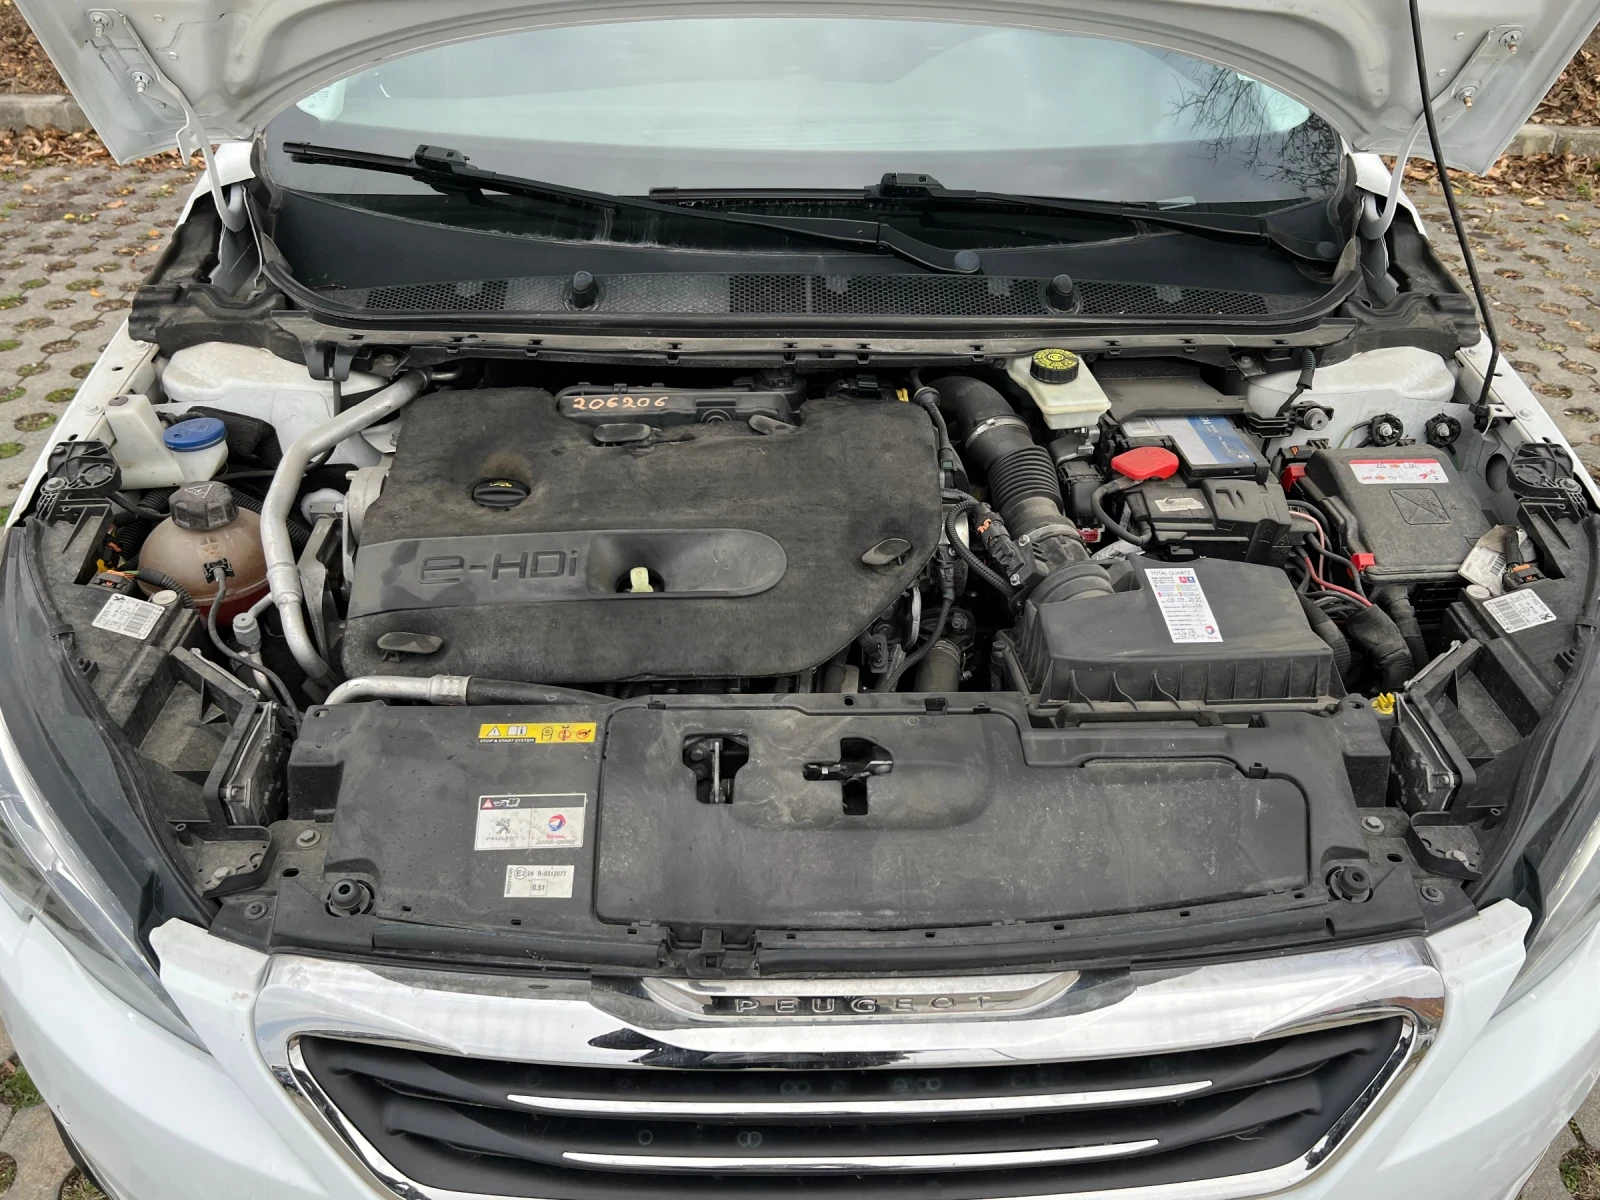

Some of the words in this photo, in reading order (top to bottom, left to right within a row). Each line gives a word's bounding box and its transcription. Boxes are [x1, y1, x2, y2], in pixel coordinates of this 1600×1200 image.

[572, 396, 669, 410] 206206
[418, 549, 579, 585] e-HDi
[735, 995, 992, 1013] PEUGEOT
